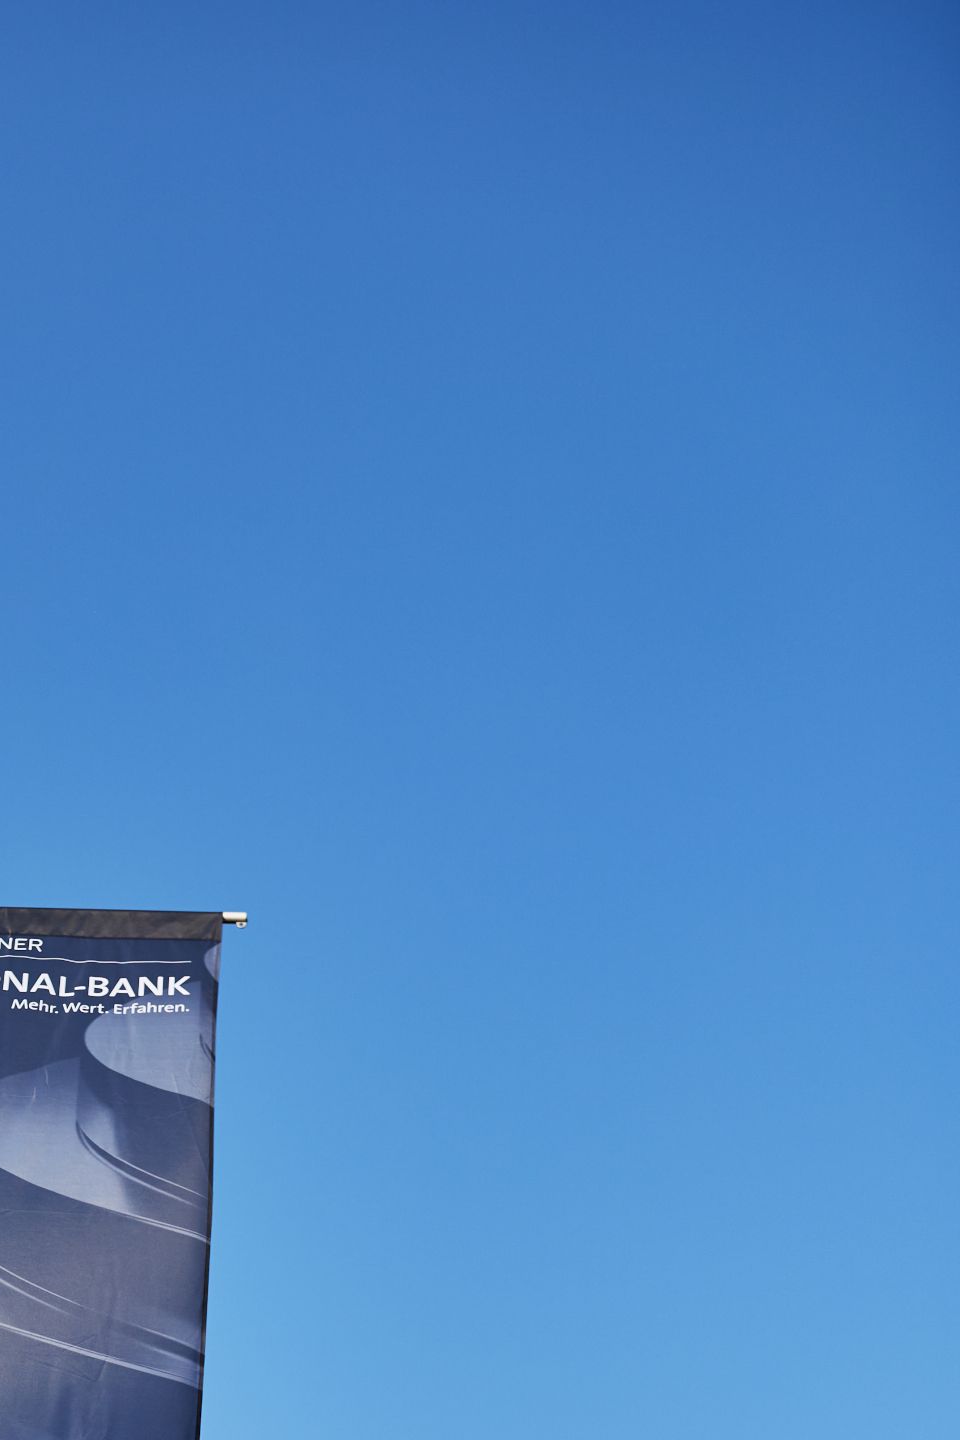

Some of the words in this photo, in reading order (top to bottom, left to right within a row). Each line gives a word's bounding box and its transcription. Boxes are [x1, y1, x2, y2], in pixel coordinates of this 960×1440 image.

[10, 998, 60, 1015] Mehr.
[63, 1001, 110, 1015] Wert.
[113, 1001, 191, 1016] Erfahren.
